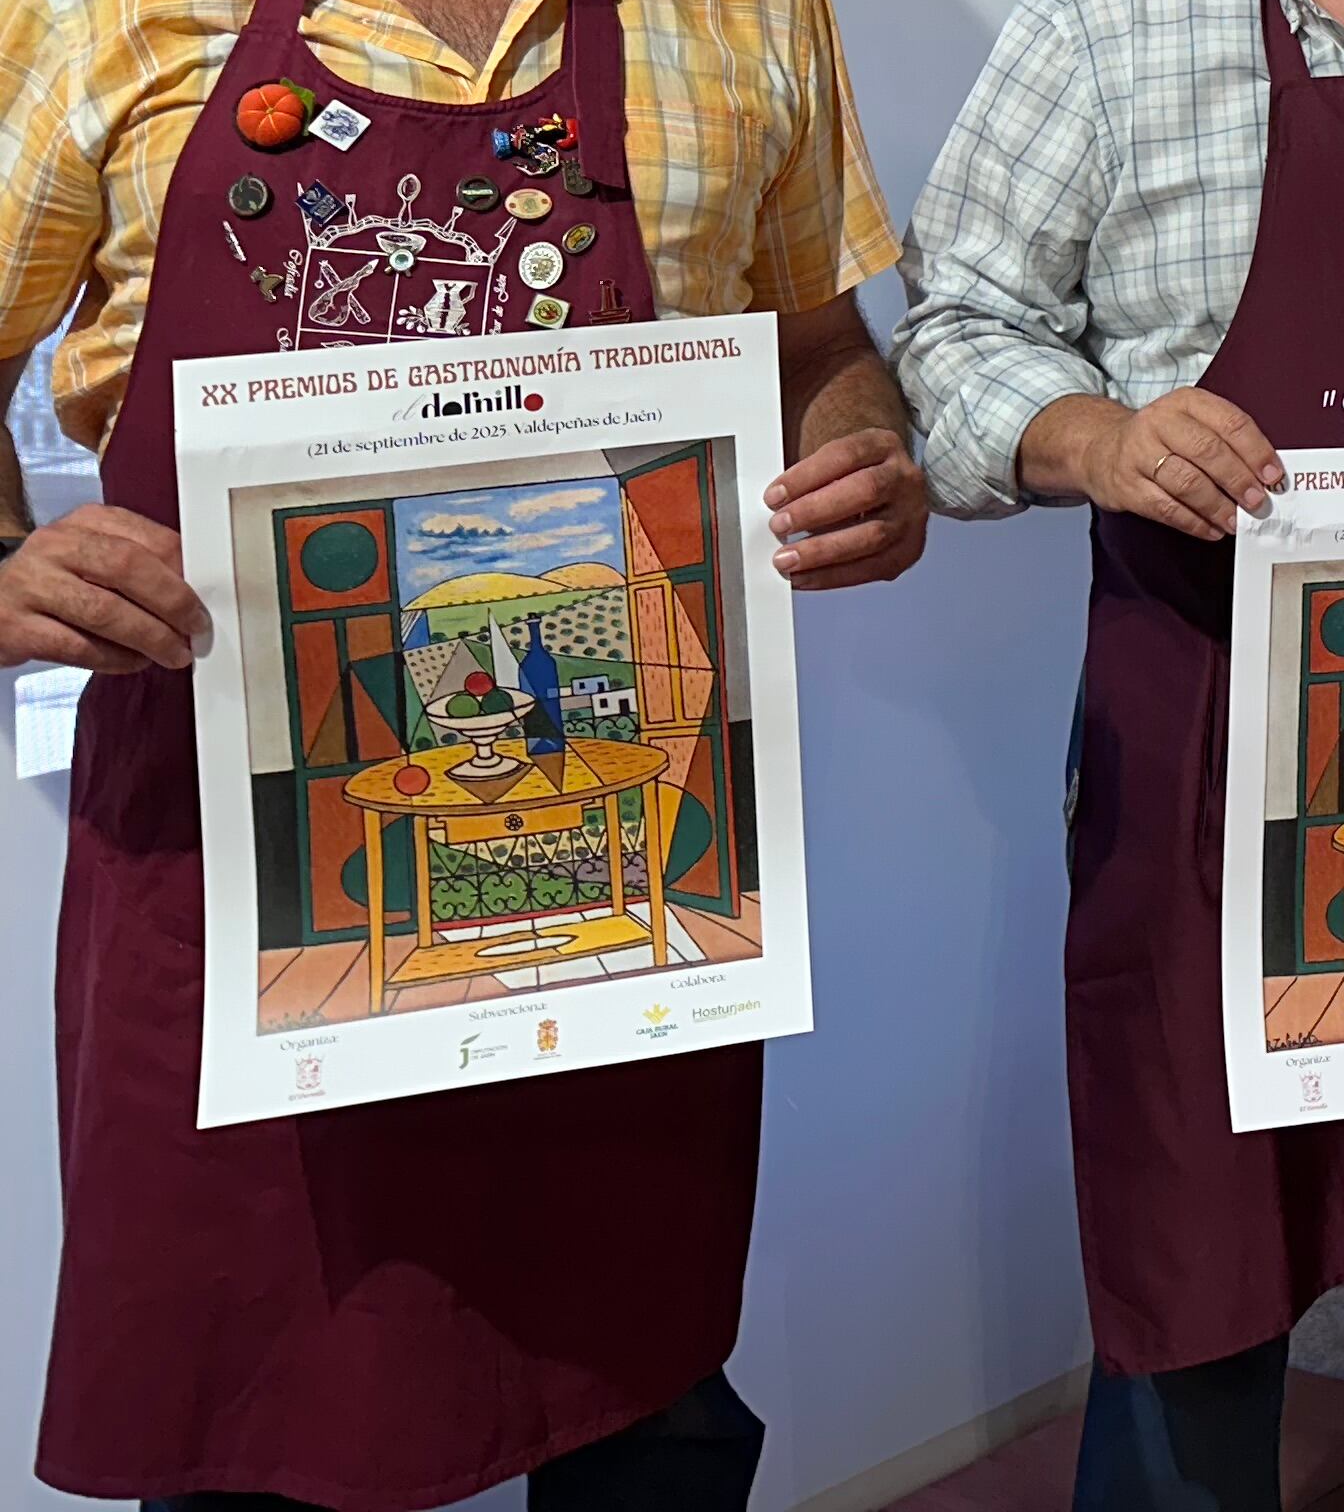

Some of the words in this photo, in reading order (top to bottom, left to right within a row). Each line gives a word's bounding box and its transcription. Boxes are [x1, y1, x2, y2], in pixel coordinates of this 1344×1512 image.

[202, 383, 238, 407] XX
[248, 372, 358, 402] PREMIOS
[367, 368, 399, 391] DE
[408, 346, 581, 387] GASTRONOMÍA
[590, 337, 741, 370] TRADICIONAL
[332, 441, 351, 454] de
[355, 431, 445, 454] septiembre
[449, 427, 468, 442] de
[514, 415, 600, 435] Valdepeñas
[603, 411, 621, 425] de
[622, 408, 663, 426] Jaén)
